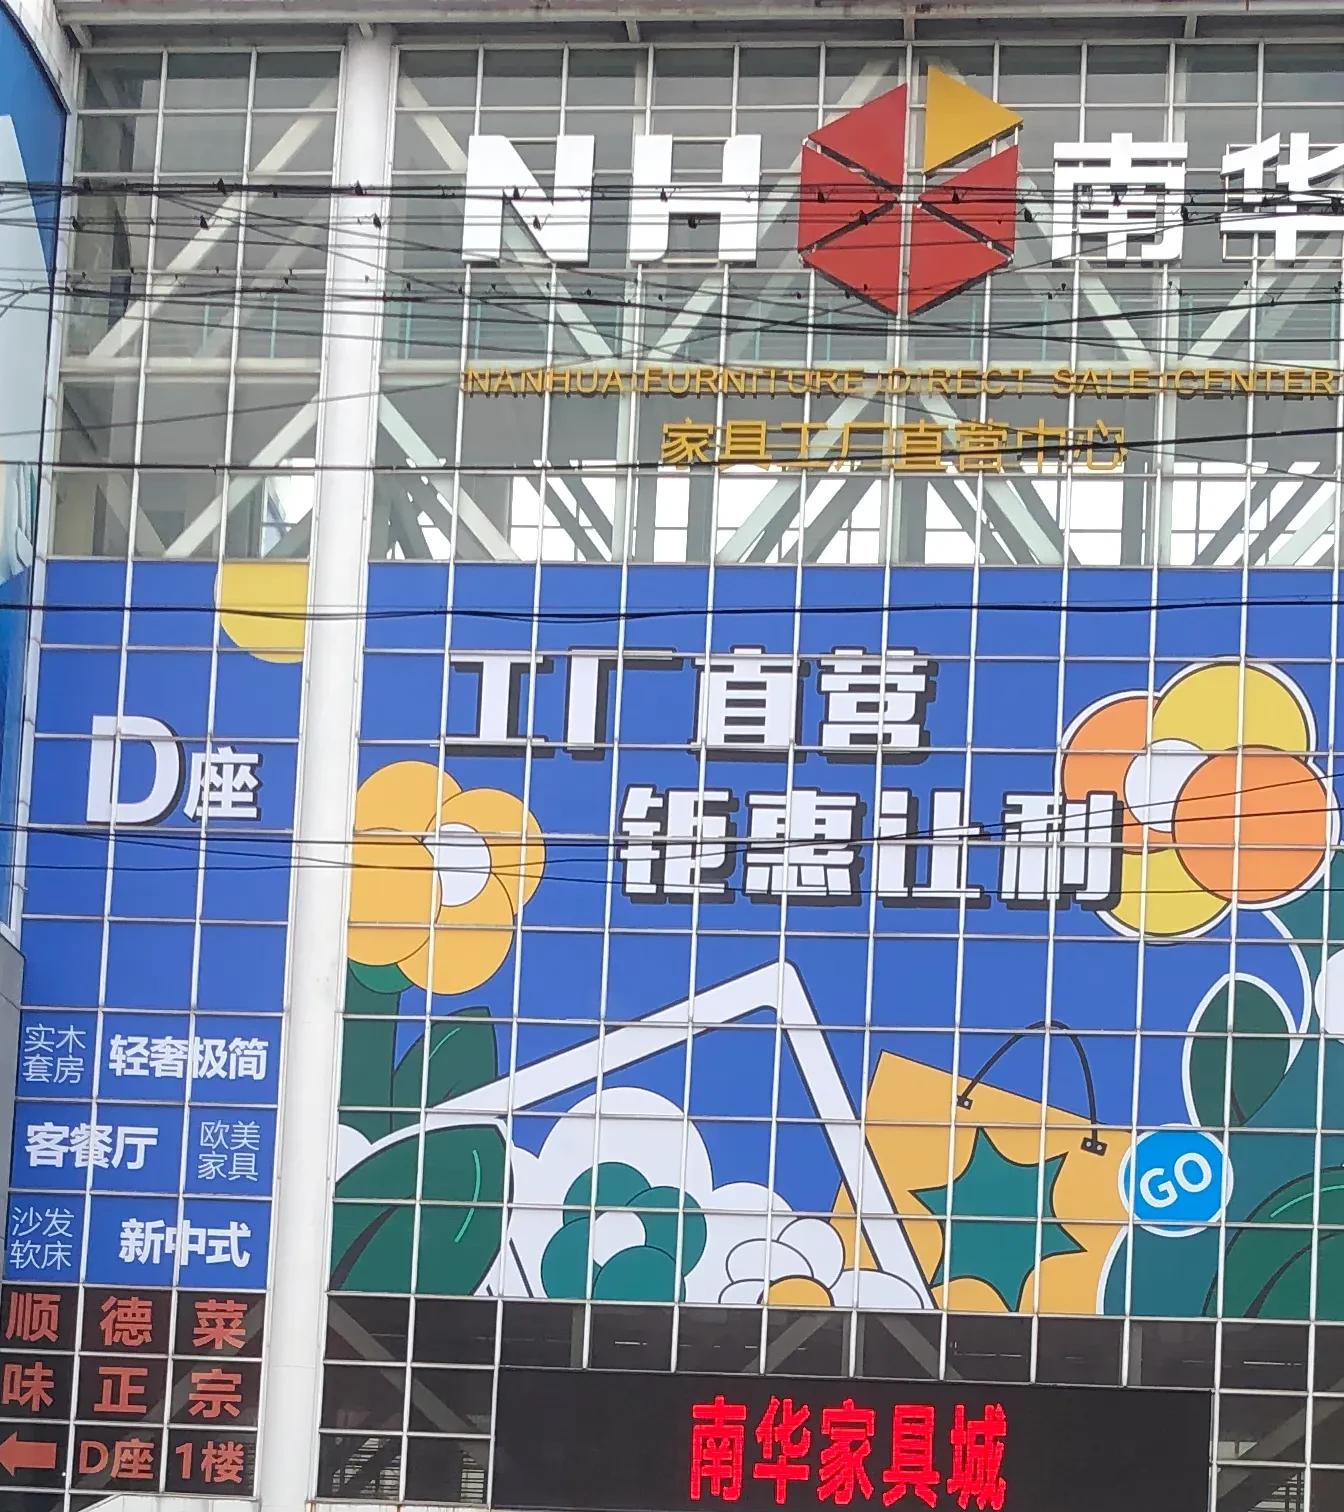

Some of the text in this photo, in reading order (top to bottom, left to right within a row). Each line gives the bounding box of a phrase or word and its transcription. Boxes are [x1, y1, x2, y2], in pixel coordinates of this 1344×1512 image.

[462, 134, 761, 263] NH
[467, 367, 1336, 396] NANHUA FURNITURE DIRECT SALE CENTER
[661, 417, 1128, 471] 家具工厂直营中心
[441, 648, 928, 753] 工厂直营
[86, 715, 259, 823] D座
[619, 787, 1114, 902] 钜惠让利
[23, 1024, 87, 1053] 实木
[108, 1033, 269, 1081] 轻奢极简
[22, 1054, 85, 1084] 套房
[25, 1121, 159, 1170] 客餐厅
[199, 1120, 261, 1151] 欧美
[197, 1151, 259, 1182] 家具
[1139, 1152, 1213, 1208] GO
[11, 1207, 75, 1238] 沙发
[118, 1217, 252, 1268] 新中式
[9, 1240, 72, 1270] 软床
[6, 1292, 247, 1349] 顺德菜
[2, 1361, 242, 1418] 味正宗
[690, 1394, 1008, 1512] 南华家具城
